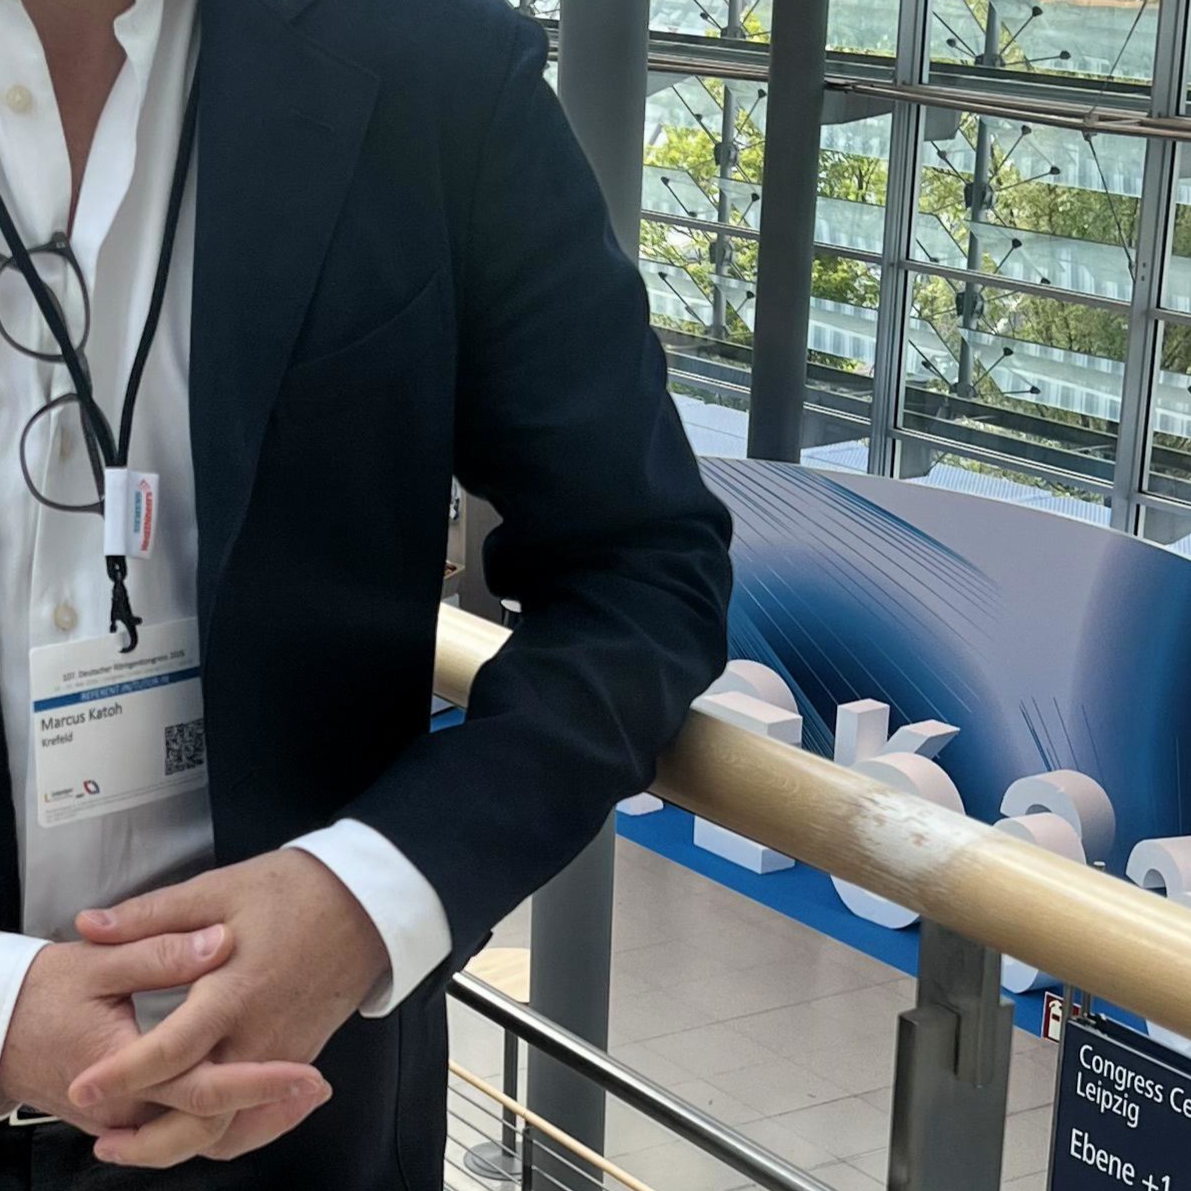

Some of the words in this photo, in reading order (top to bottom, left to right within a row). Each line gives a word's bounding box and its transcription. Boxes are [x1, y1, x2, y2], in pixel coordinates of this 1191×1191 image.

[41, 713, 85, 731] Marcus
[88, 702, 123, 721] Katoh
[41, 731, 73, 748] Krefeld
[1076, 1071, 1140, 1128] Leipzig
[1079, 1044, 1164, 1103] Congress
[1070, 1128, 1135, 1186] Ebene
